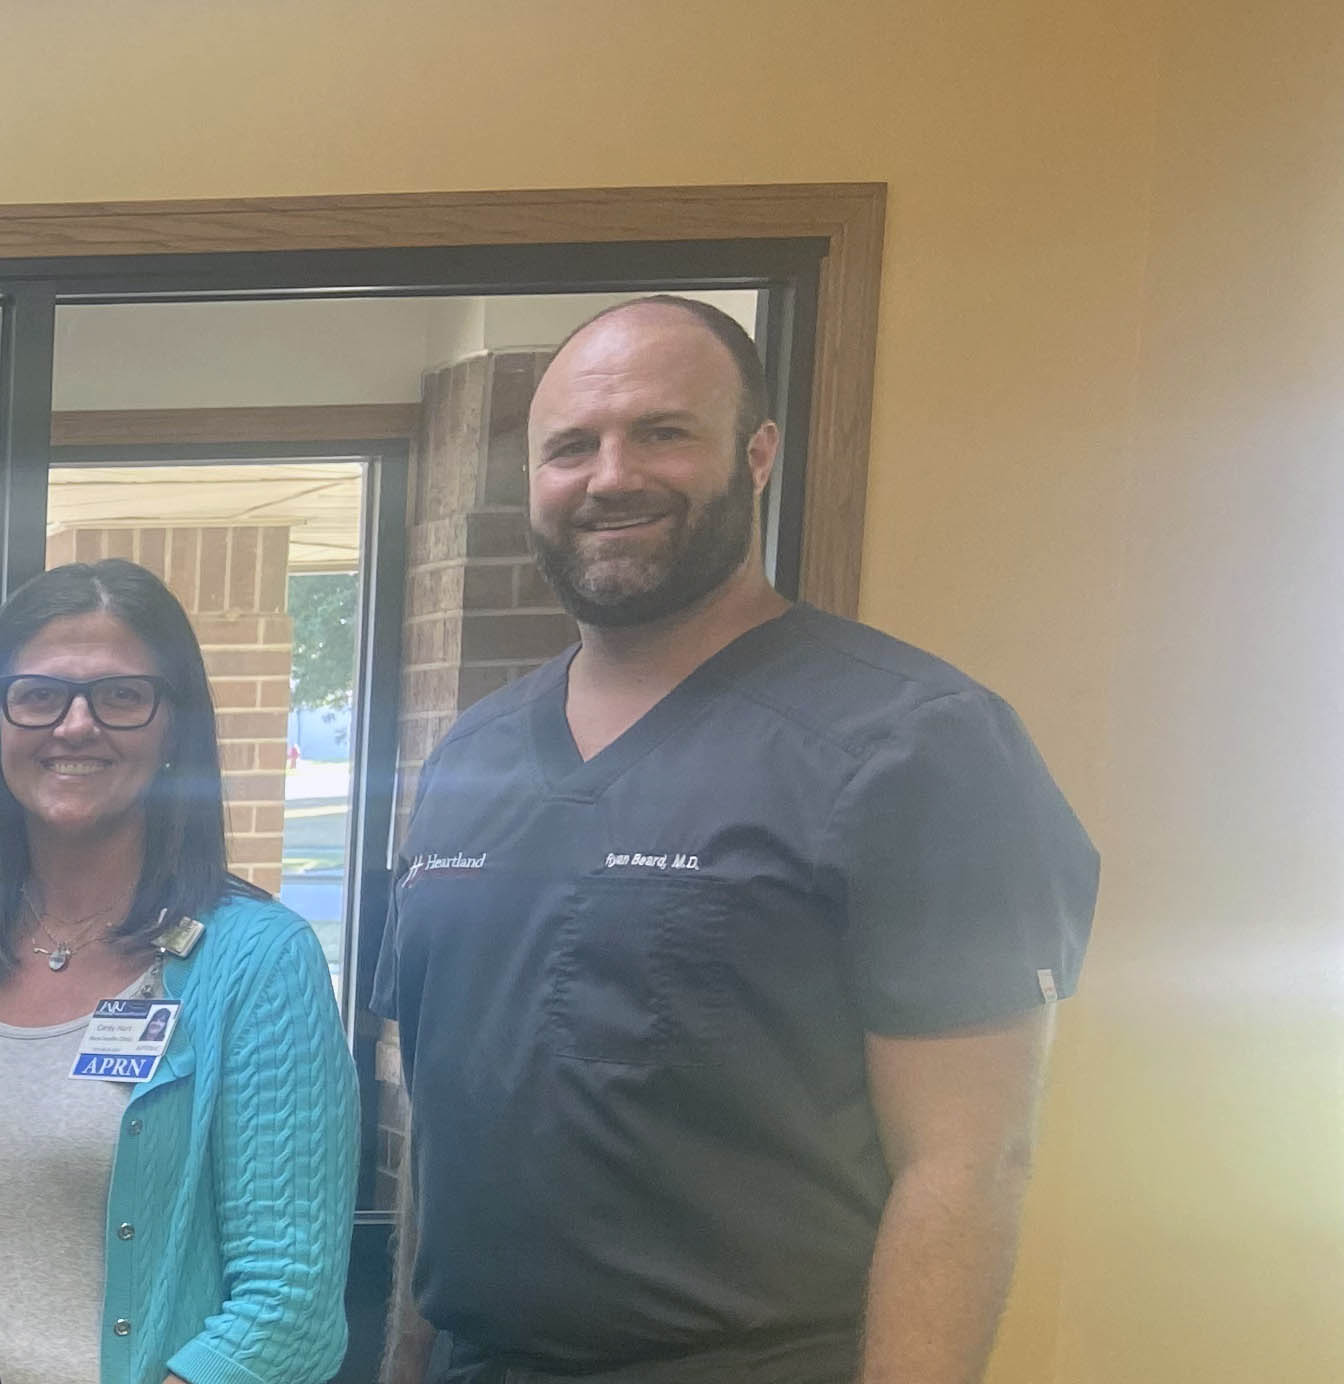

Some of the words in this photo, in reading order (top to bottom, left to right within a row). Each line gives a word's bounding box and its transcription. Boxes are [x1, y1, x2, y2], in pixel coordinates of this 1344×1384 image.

[424, 852, 486, 870] Heartland
[605, 853, 629, 868] Ryan
[672, 854, 700, 870] M.D.
[82, 1056, 147, 1076] APRN
